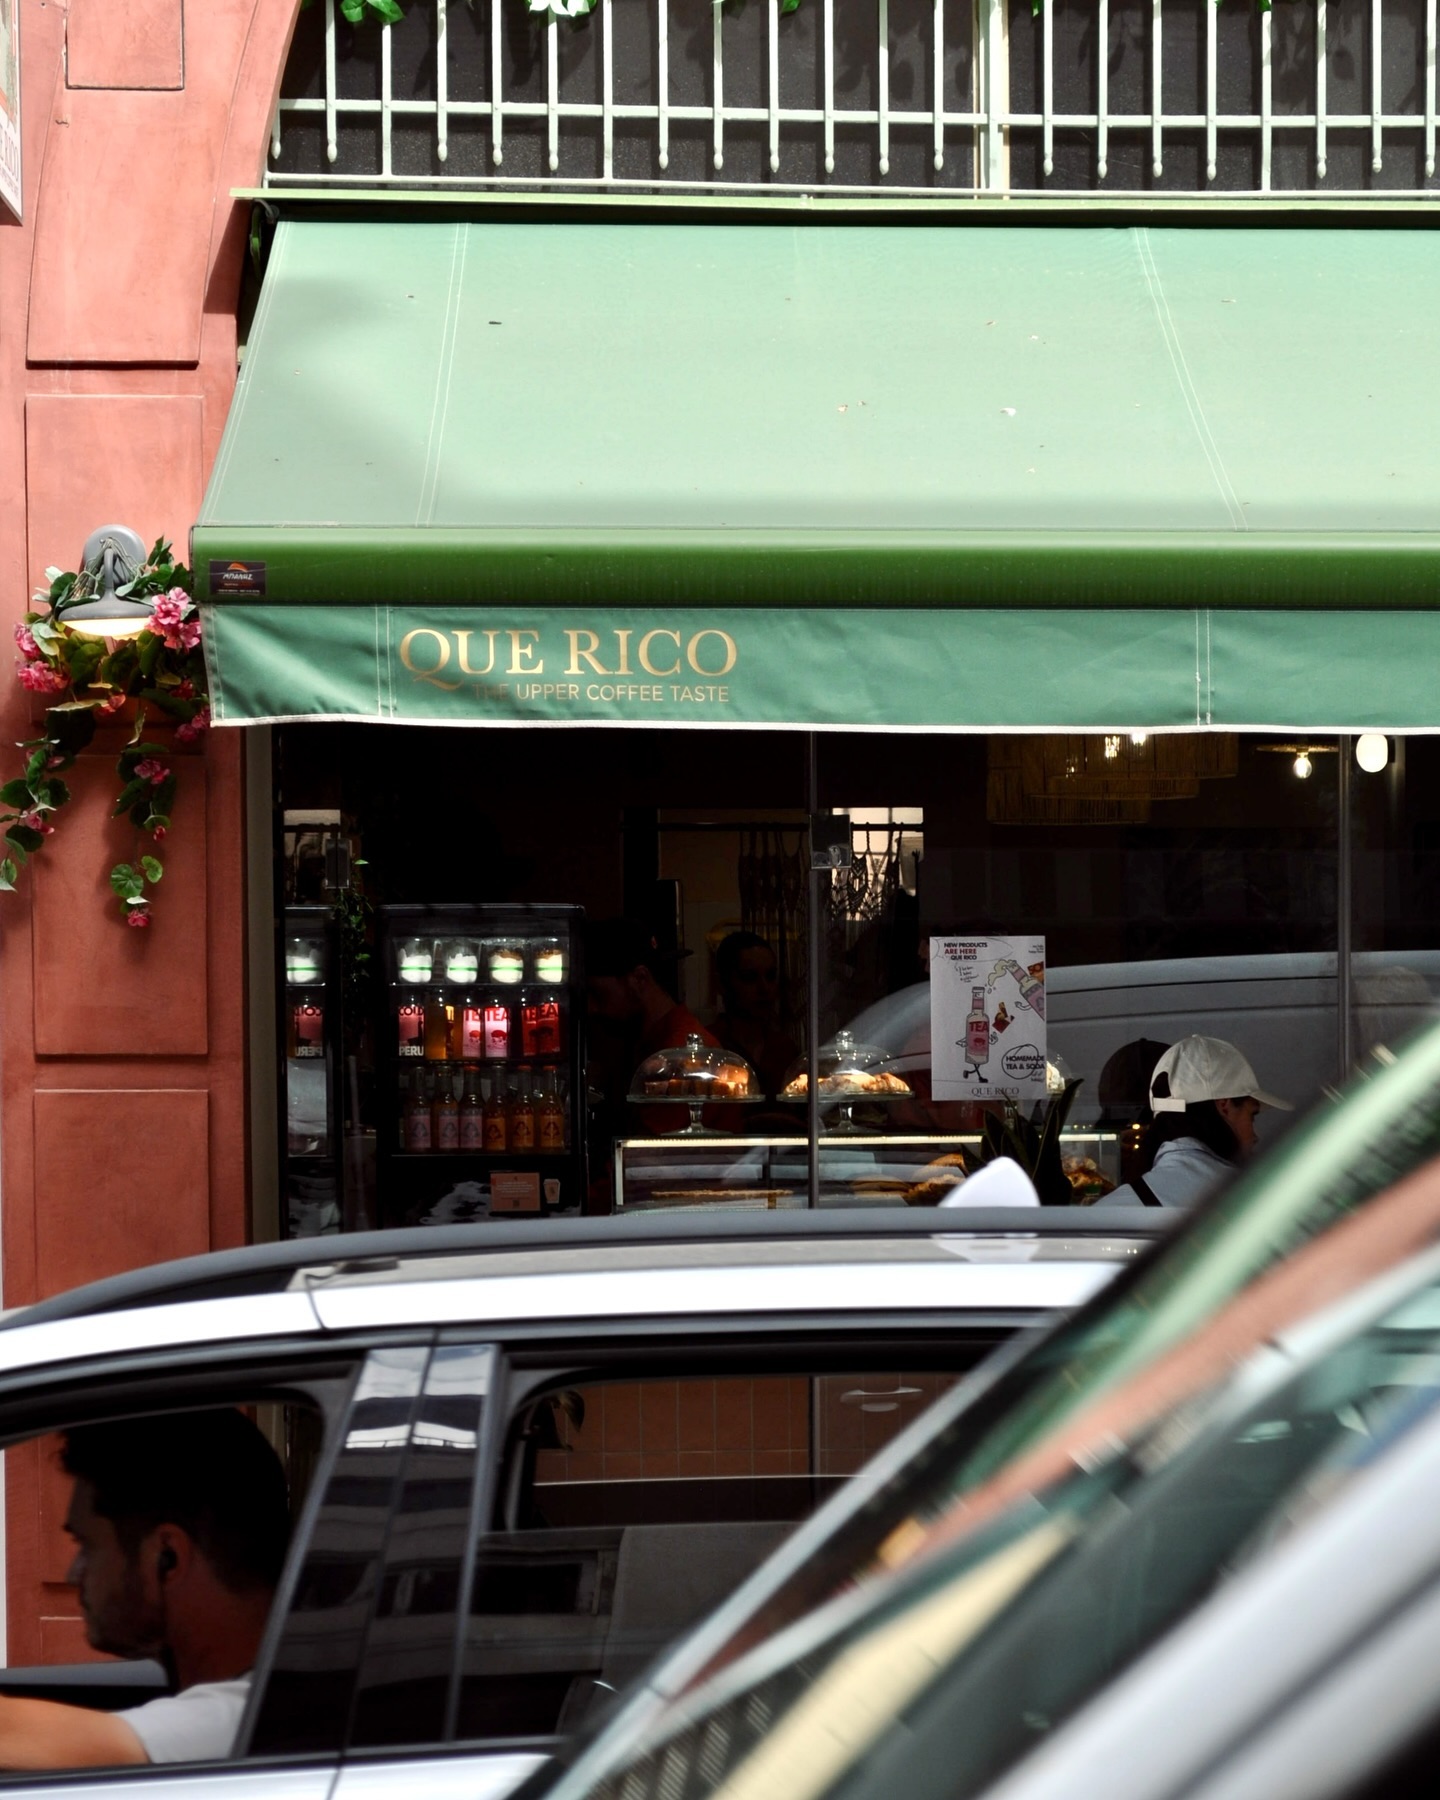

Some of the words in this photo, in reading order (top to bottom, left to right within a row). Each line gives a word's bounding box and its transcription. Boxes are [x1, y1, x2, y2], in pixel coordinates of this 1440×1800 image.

[400, 628, 544, 691] QUE
[563, 629, 737, 676] RICO
[472, 684, 509, 698] THE
[516, 683, 580, 700] UPPER
[586, 684, 664, 701] COFFEE
[670, 685, 729, 702] TASTE
[969, 1021, 989, 1032] TEA
[398, 1045, 424, 1057] PERU
[971, 1087, 992, 1097] QUE
